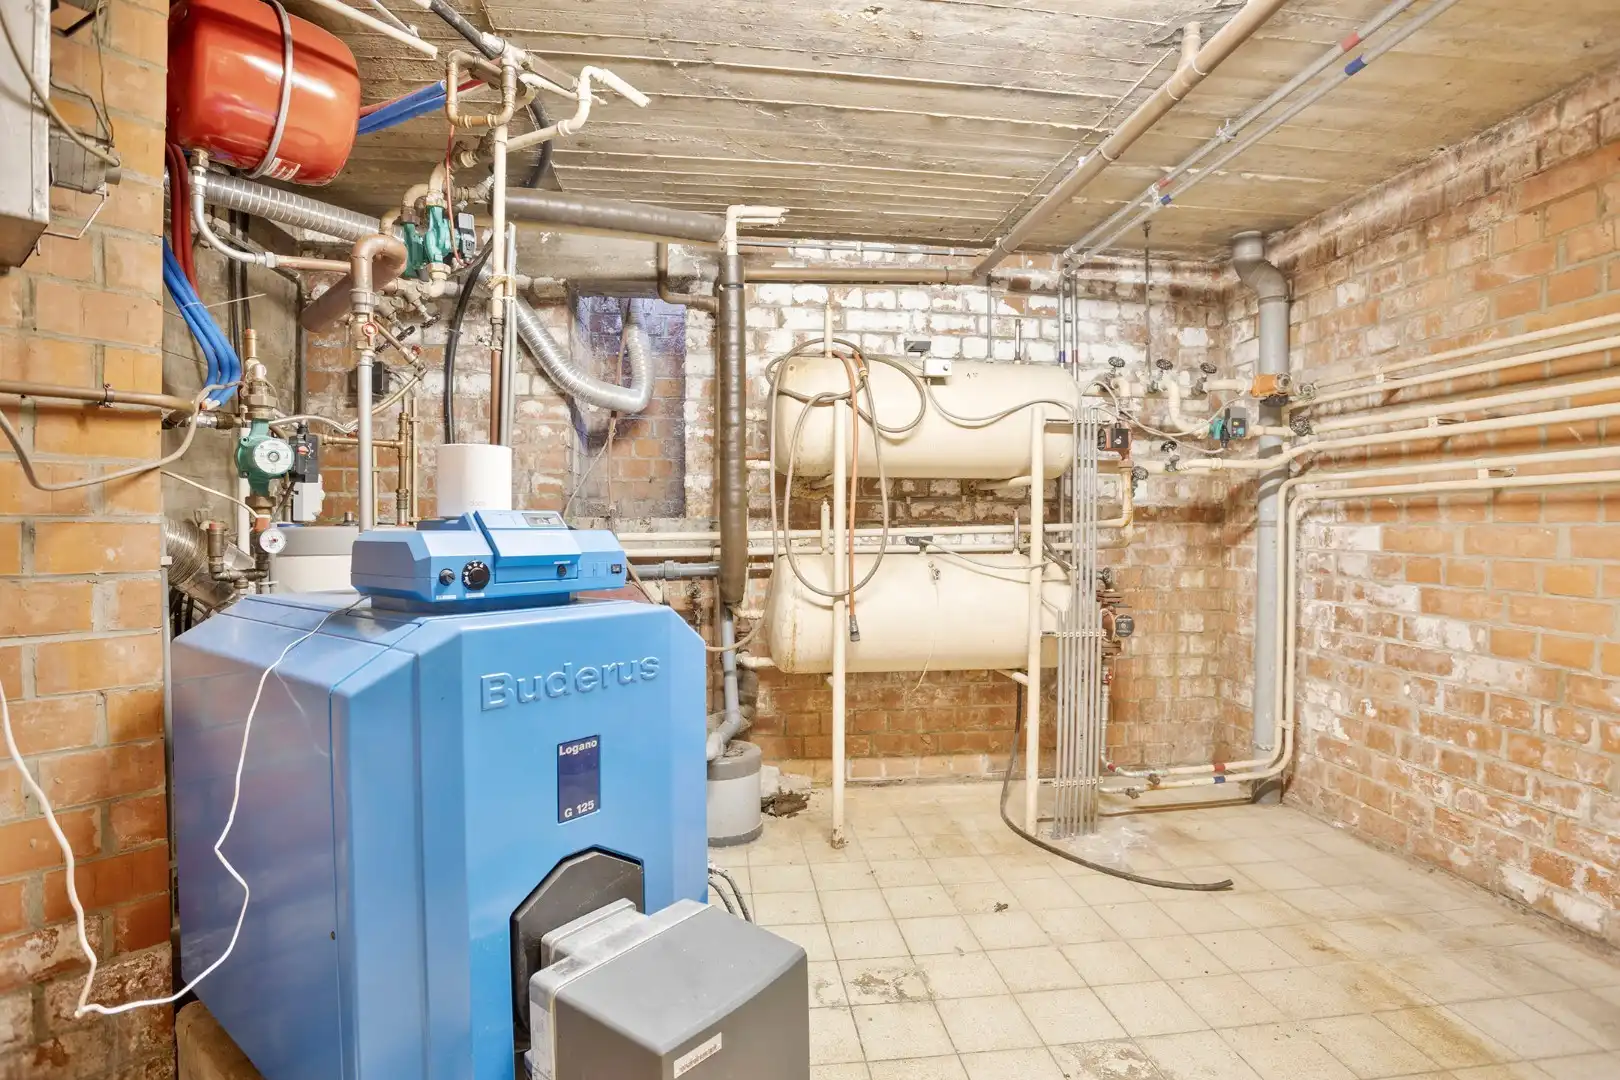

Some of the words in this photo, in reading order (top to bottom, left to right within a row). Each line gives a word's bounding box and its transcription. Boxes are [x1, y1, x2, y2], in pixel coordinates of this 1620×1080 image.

[480, 656, 660, 712] Buderus
[558, 738, 598, 756] Logano
[564, 807, 573, 819] G
[576, 800, 595, 815] 125
